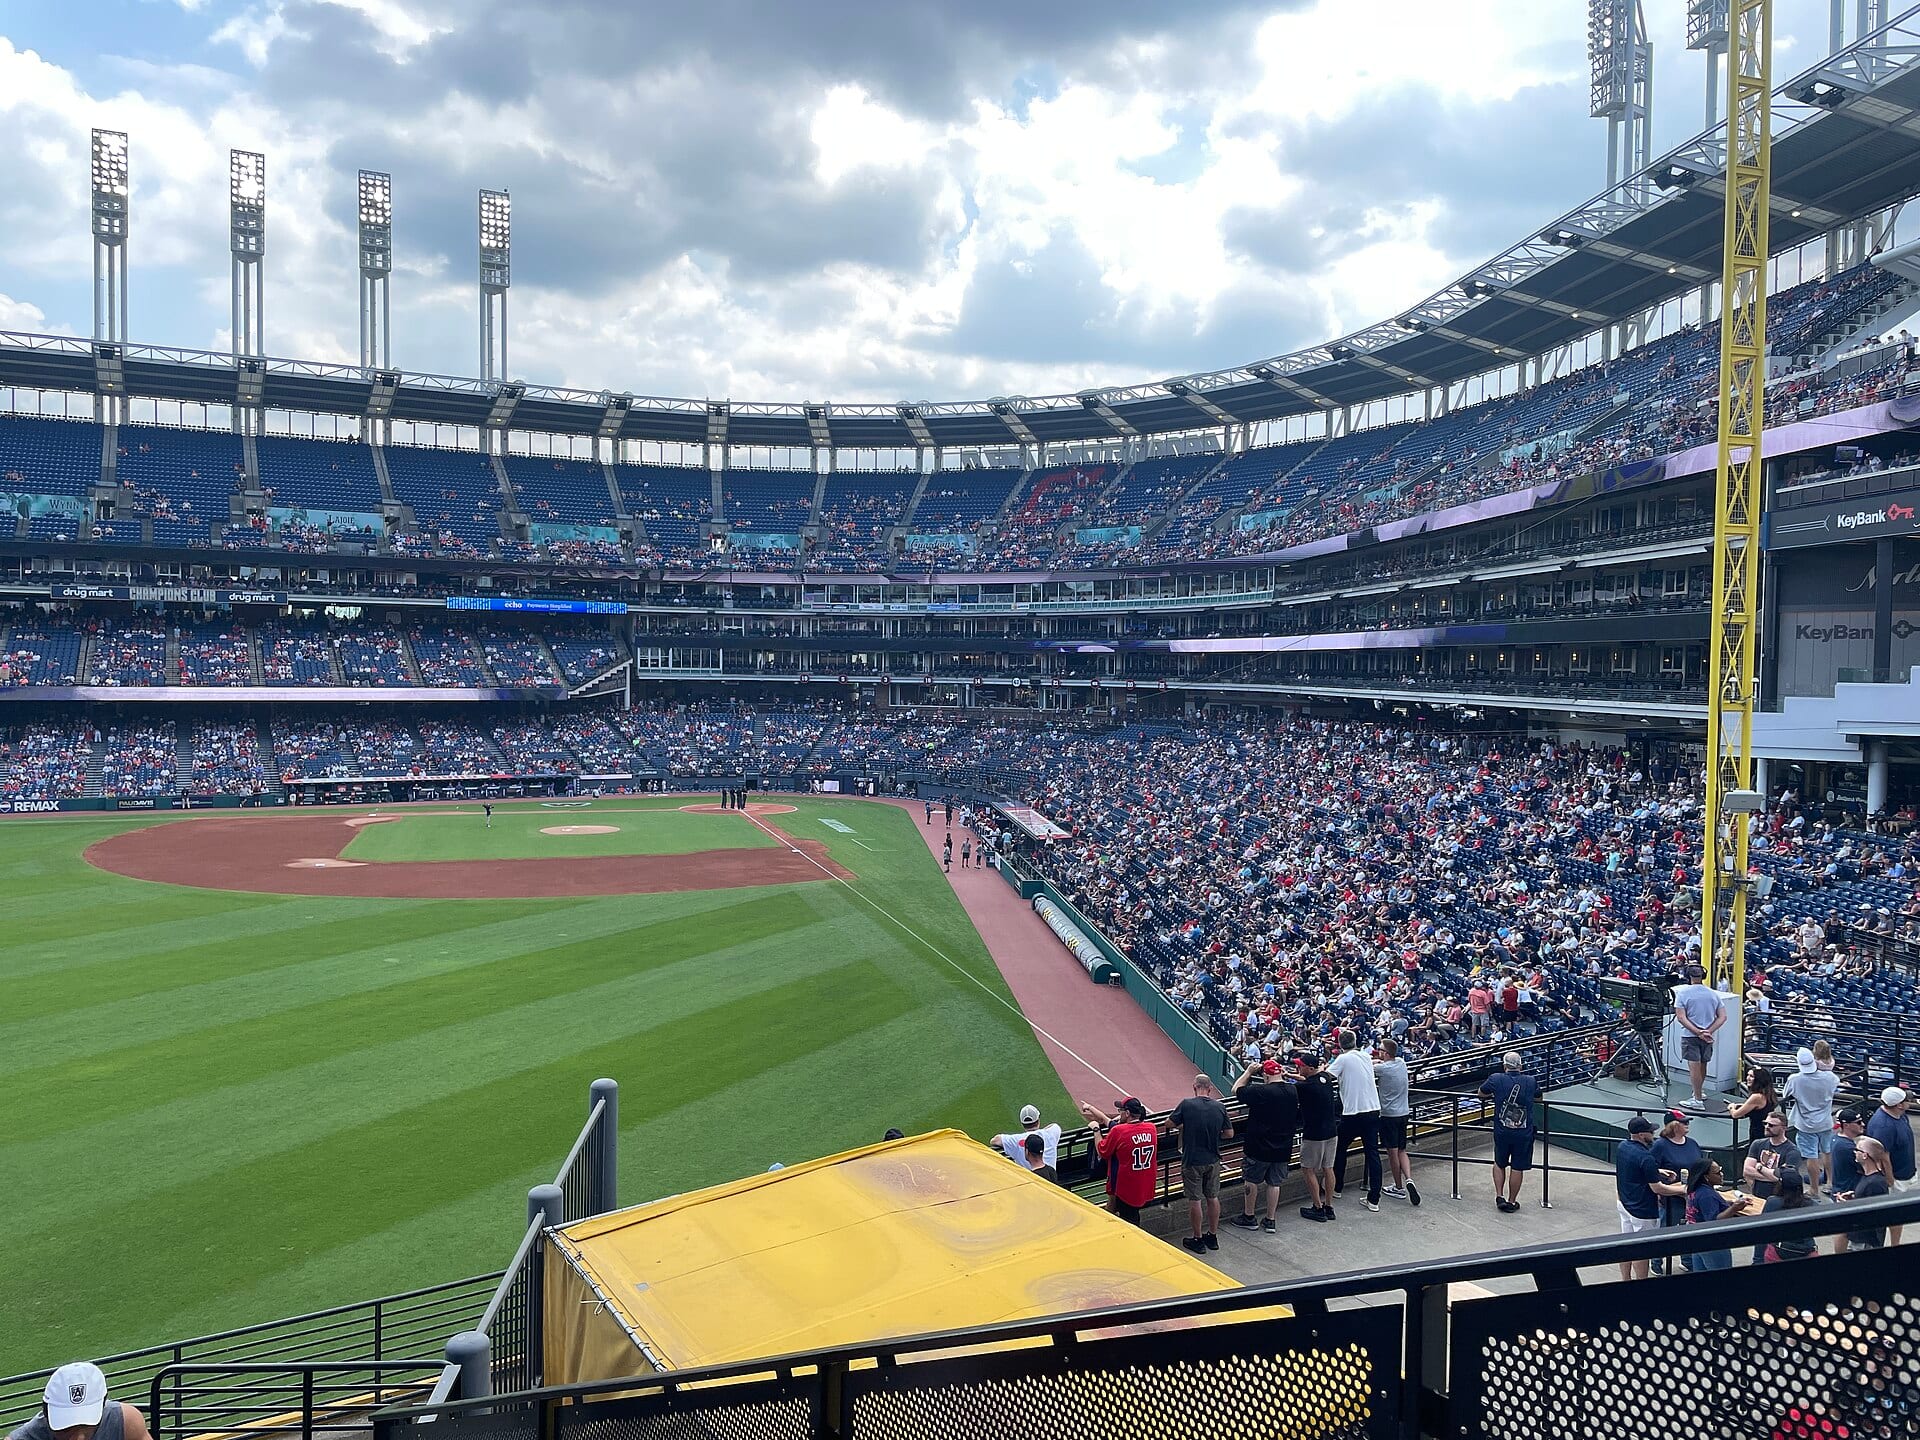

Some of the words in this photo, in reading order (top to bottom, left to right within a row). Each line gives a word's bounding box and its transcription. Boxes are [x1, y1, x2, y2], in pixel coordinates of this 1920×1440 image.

[1837, 509, 1886, 529] KeyBank
[63, 587, 87, 598] drug
[89, 589, 113, 597] mart
[129, 587, 187, 601] CHAMPIONS
[191, 587, 216, 602] CLUB
[229, 593, 251, 602] drug
[253, 594, 275, 602] mart
[504, 600, 522, 609] echo
[1795, 624, 1874, 642] KeyBan
[14, 800, 60, 812] REMAX
[1132, 1133, 1152, 1144] CHOO
[1132, 1145, 1154, 1170] 17
